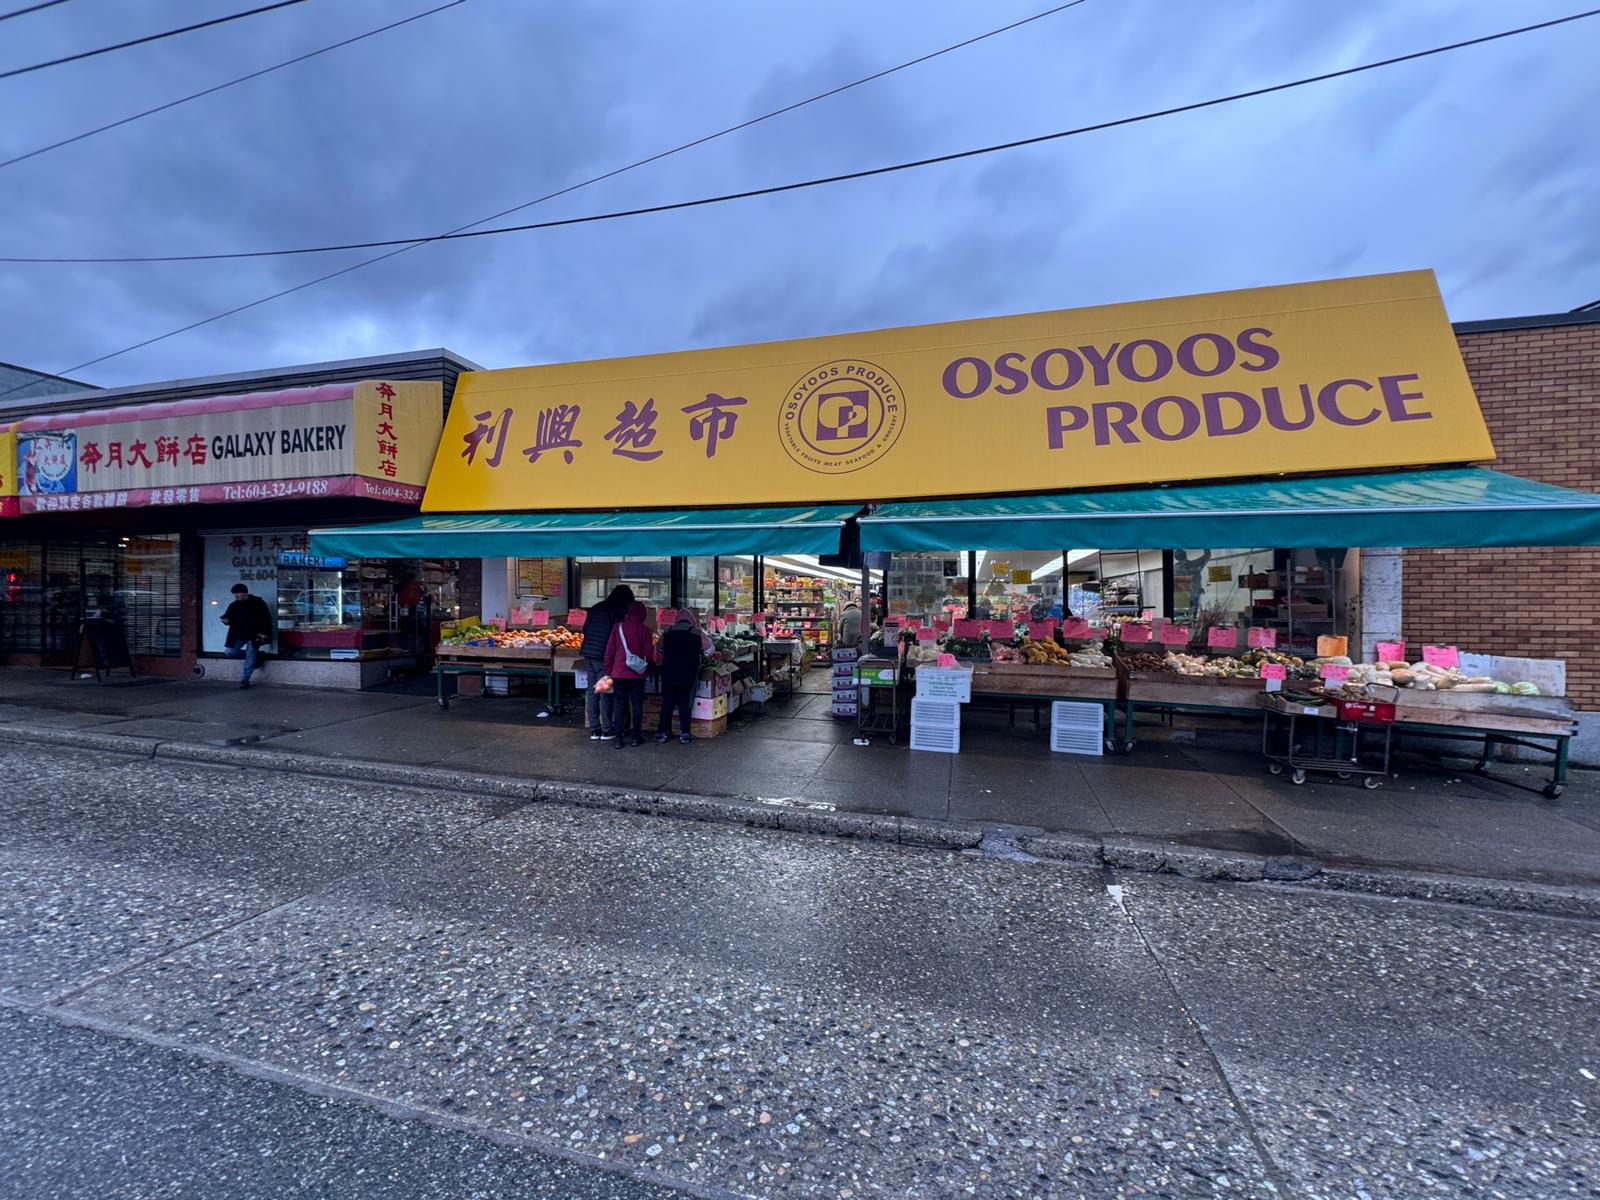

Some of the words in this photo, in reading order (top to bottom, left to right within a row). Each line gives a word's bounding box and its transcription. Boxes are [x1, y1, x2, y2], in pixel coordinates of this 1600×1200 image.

[942, 328, 1280, 399] OSOYOOS
[785, 366, 840, 421] OSOYOOS
[846, 365, 898, 413] PRODUCE
[1046, 373, 1432, 449] PRODUCE
[212, 430, 276, 460] GALAXY
[281, 424, 347, 454] BAKERY
[461, 392, 749, 468] 利興超市
[784, 422, 801, 453] VEGETABLE
[801, 452, 822, 465] FRUITS
[845, 448, 876, 466] SEAFOOD
[882, 415, 898, 442] GROCERY
[223, 479, 328, 500] Tel:604-324-9188
[232, 555, 278, 569] GALAXY
